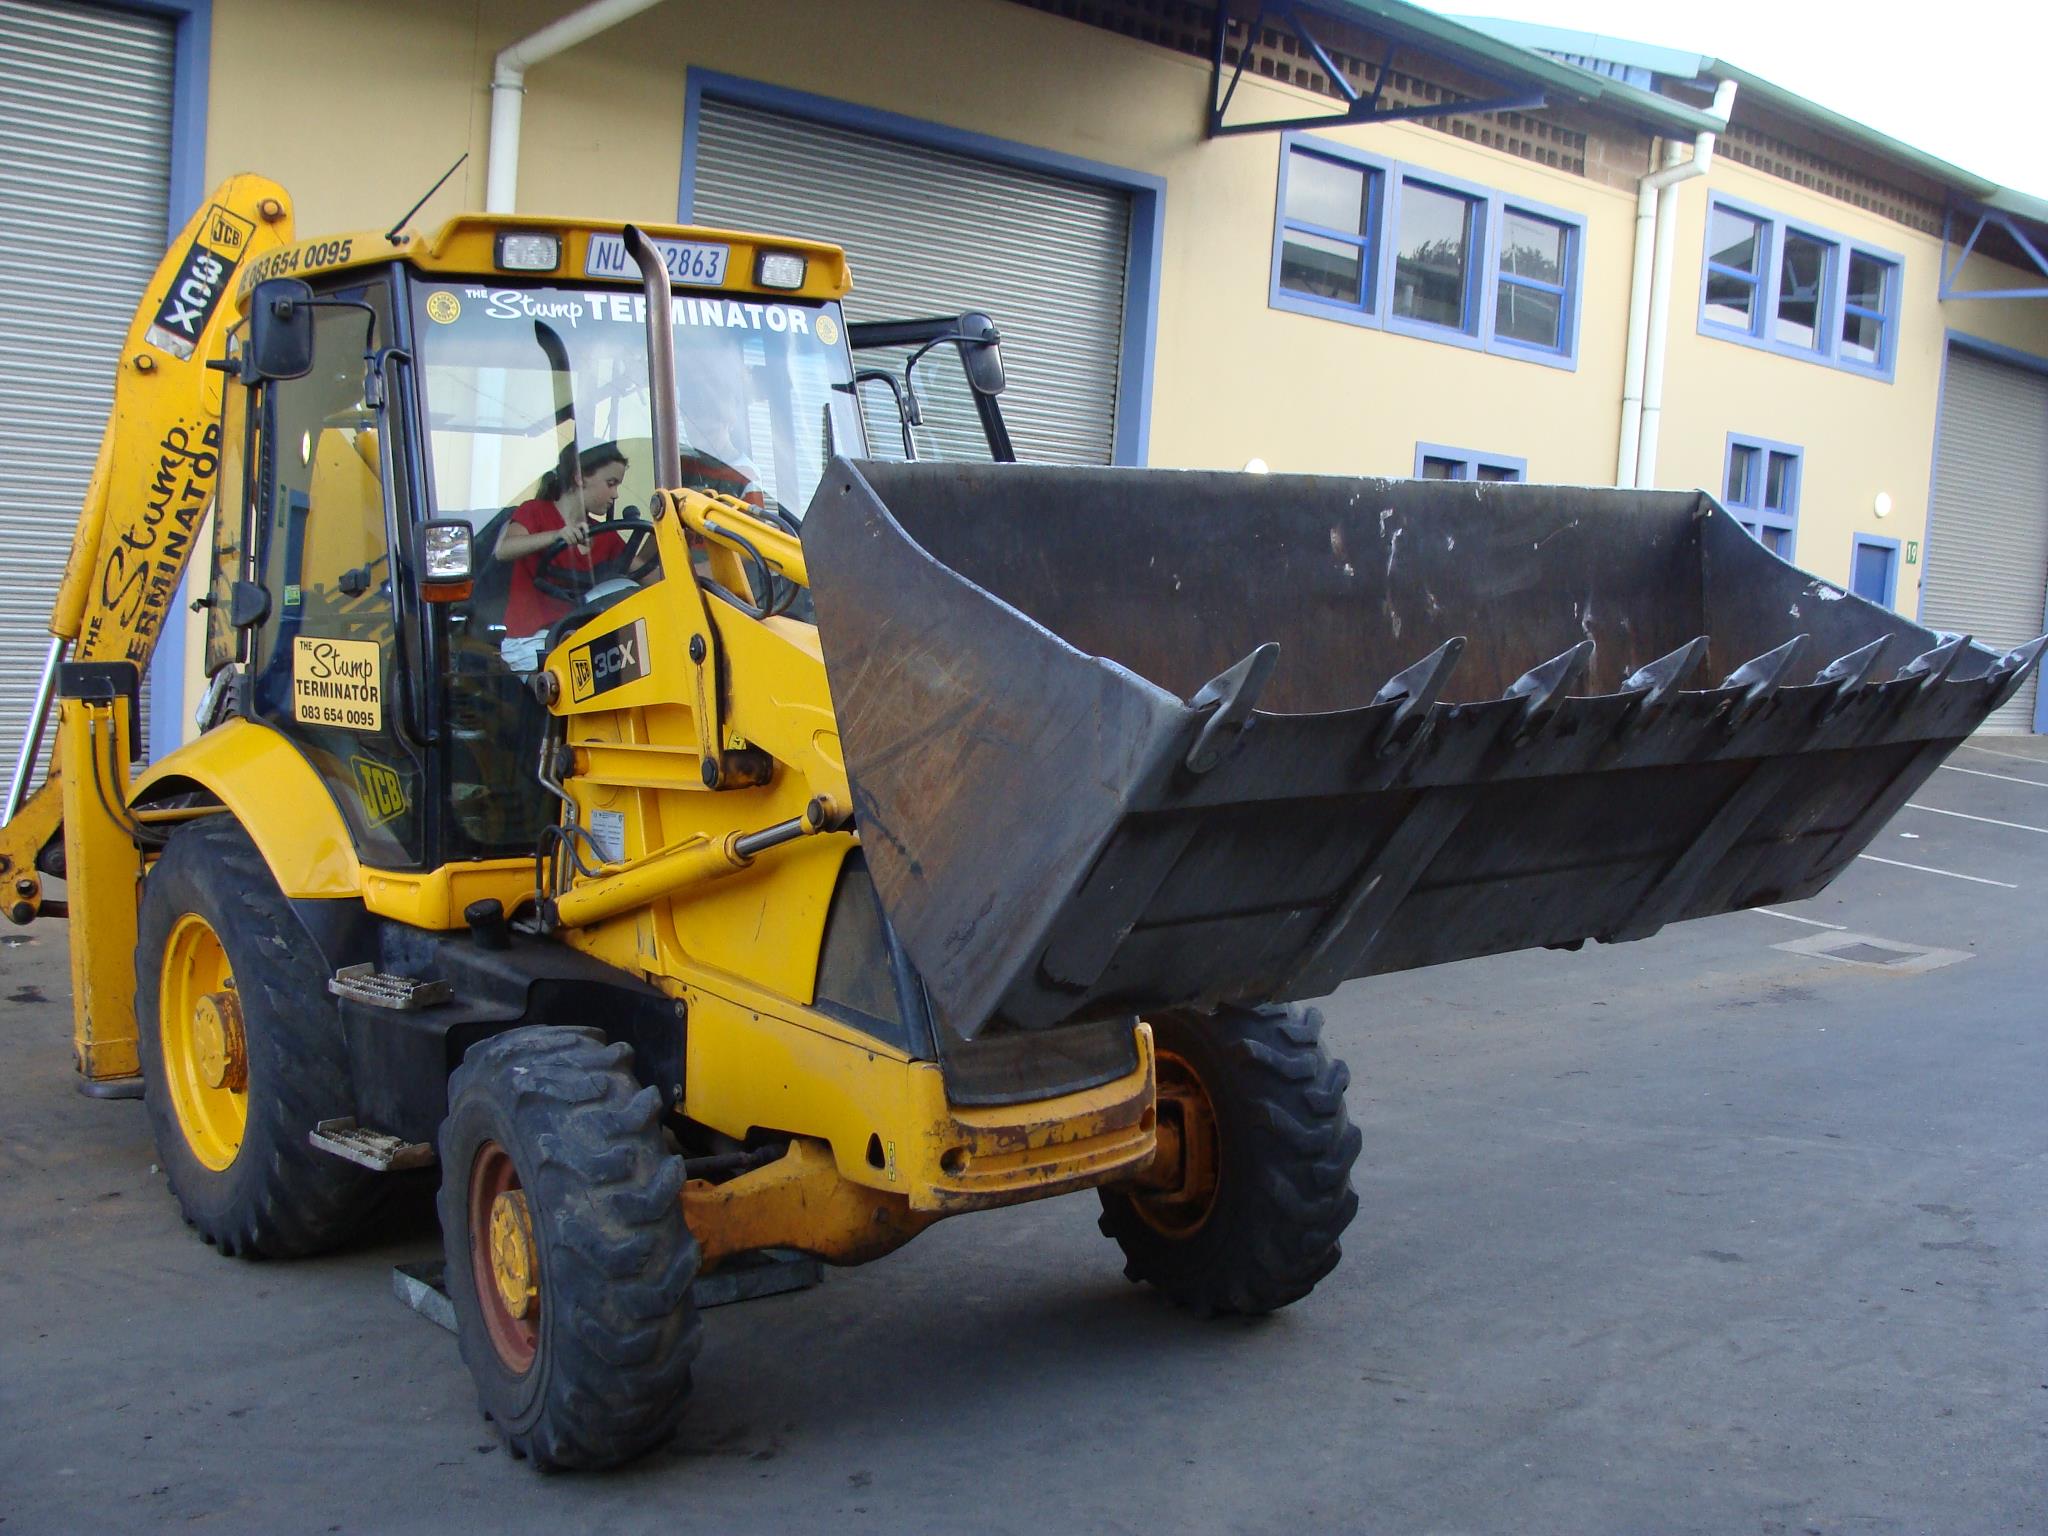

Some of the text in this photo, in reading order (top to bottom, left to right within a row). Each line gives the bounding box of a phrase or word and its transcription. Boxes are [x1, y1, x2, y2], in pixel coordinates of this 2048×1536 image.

[213, 219, 240, 246] JCB
[270, 249, 300, 277] 654
[304, 239, 353, 269] 0095
[596, 240, 721, 279] NU 2863
[164, 255, 223, 334] 3CX
[465, 288, 488, 299] THE
[485, 289, 583, 328] Stump
[125, 423, 221, 661] ERMINATOR
[1907, 543, 1917, 561] 19
[82, 615, 103, 659] THE
[300, 640, 373, 690] THE Stump
[594, 639, 636, 678] 3CX
[296, 679, 378, 703] TERMINATOR
[302, 705, 375, 726] 083 654 0095
[359, 764, 401, 819] JCB
